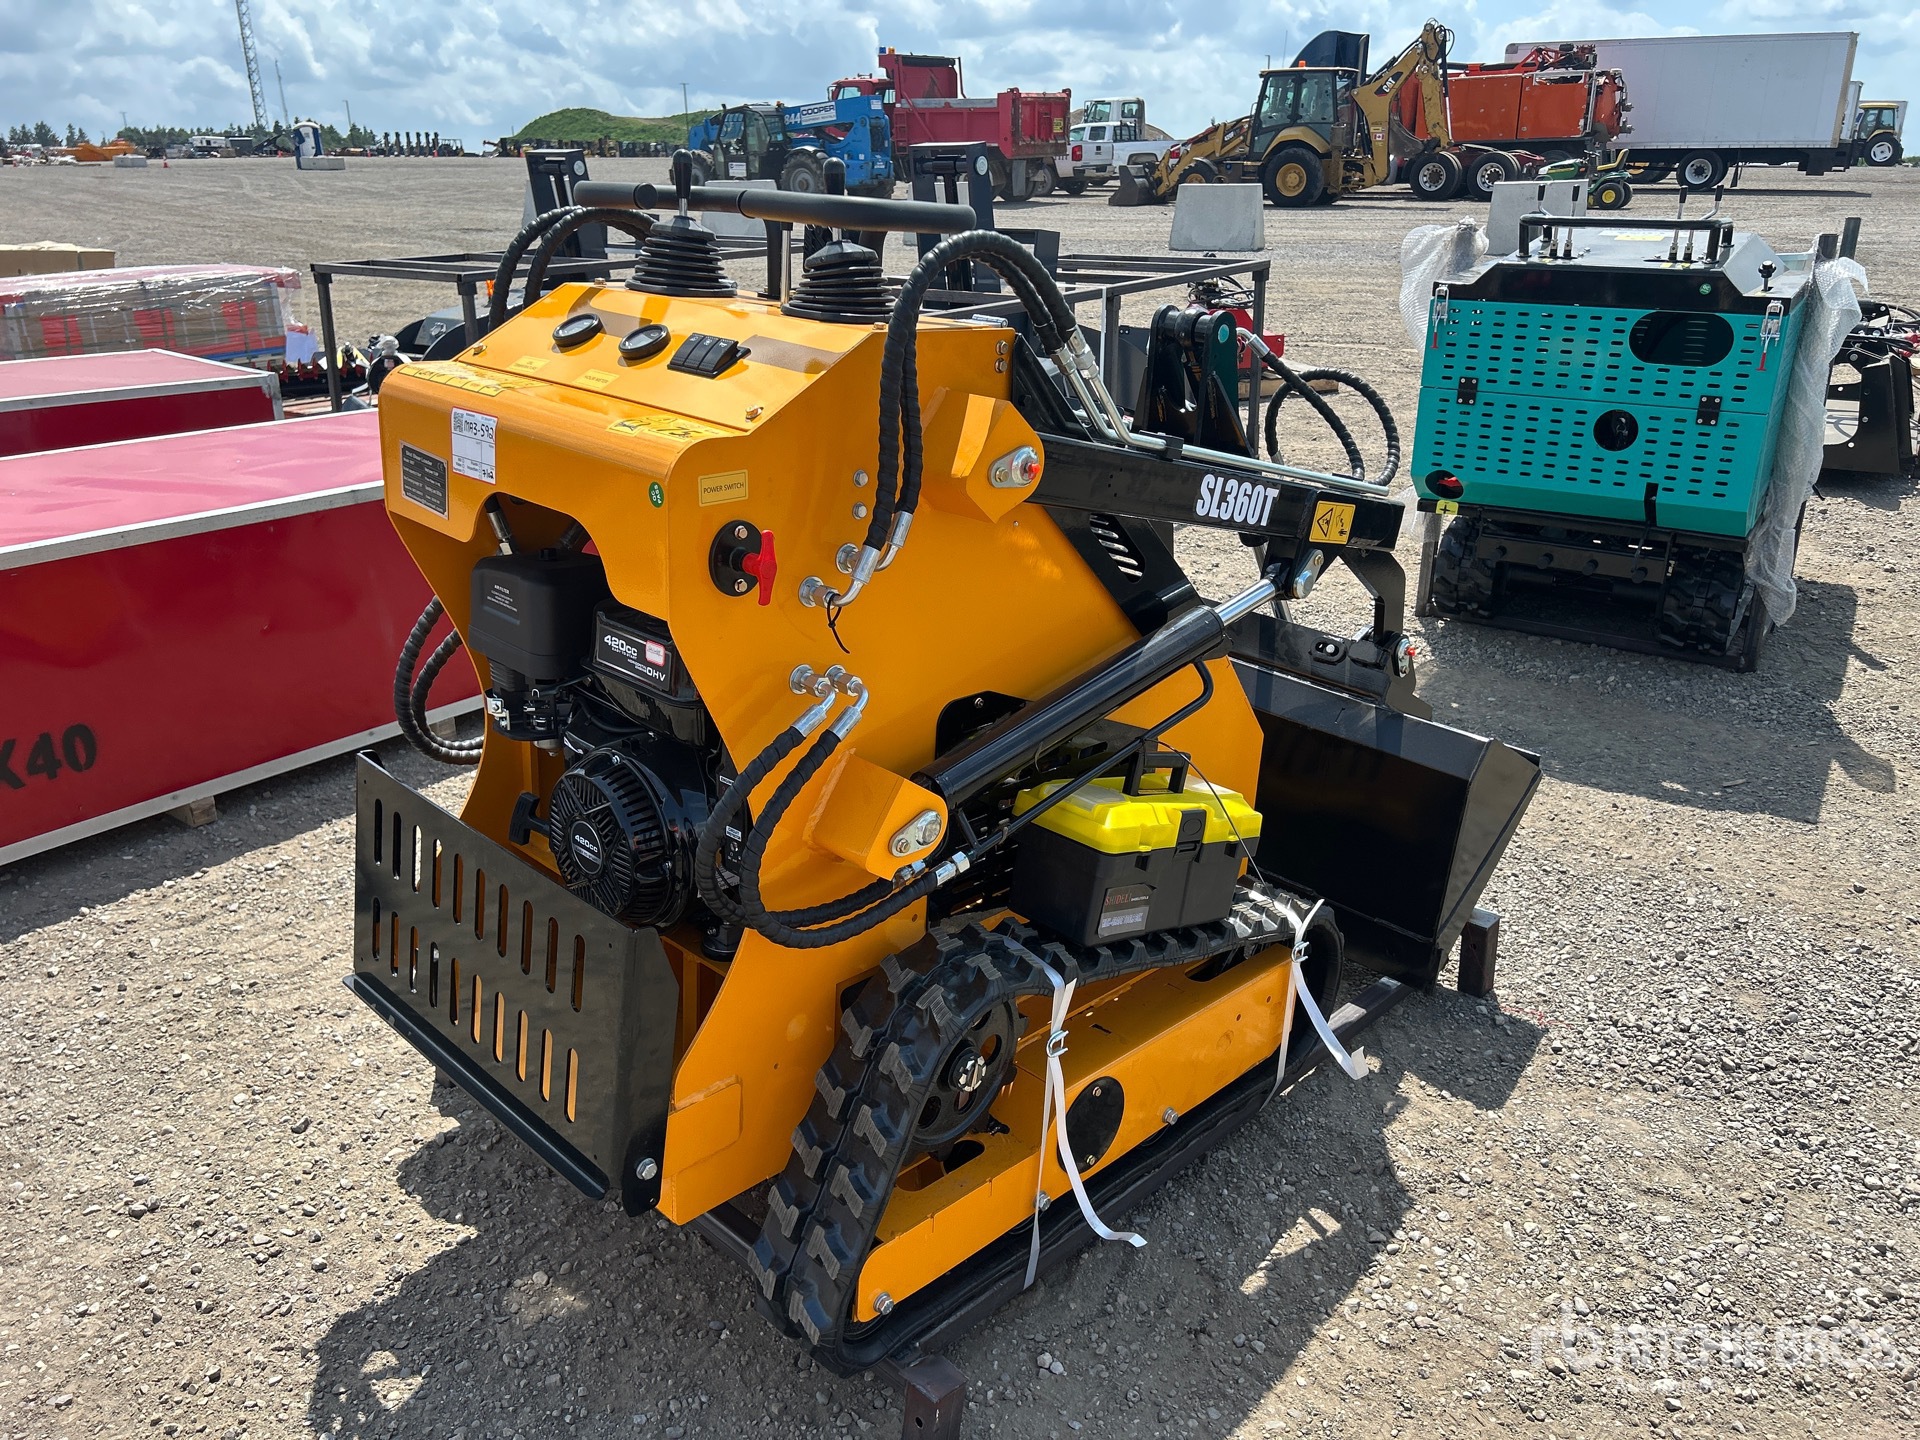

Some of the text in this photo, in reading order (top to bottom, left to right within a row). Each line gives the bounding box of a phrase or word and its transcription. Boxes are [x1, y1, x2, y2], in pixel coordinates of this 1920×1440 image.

[1382, 77, 1396, 93] CAT
[801, 104, 835, 116] COOPER
[784, 113, 801, 126] 844
[703, 482, 744, 494] POWER SWITCH
[1195, 473, 1279, 527] SL360T
[604, 634, 638, 657] 420cc
[646, 666, 666, 682] OHV
[574, 834, 598, 853] 420cc
